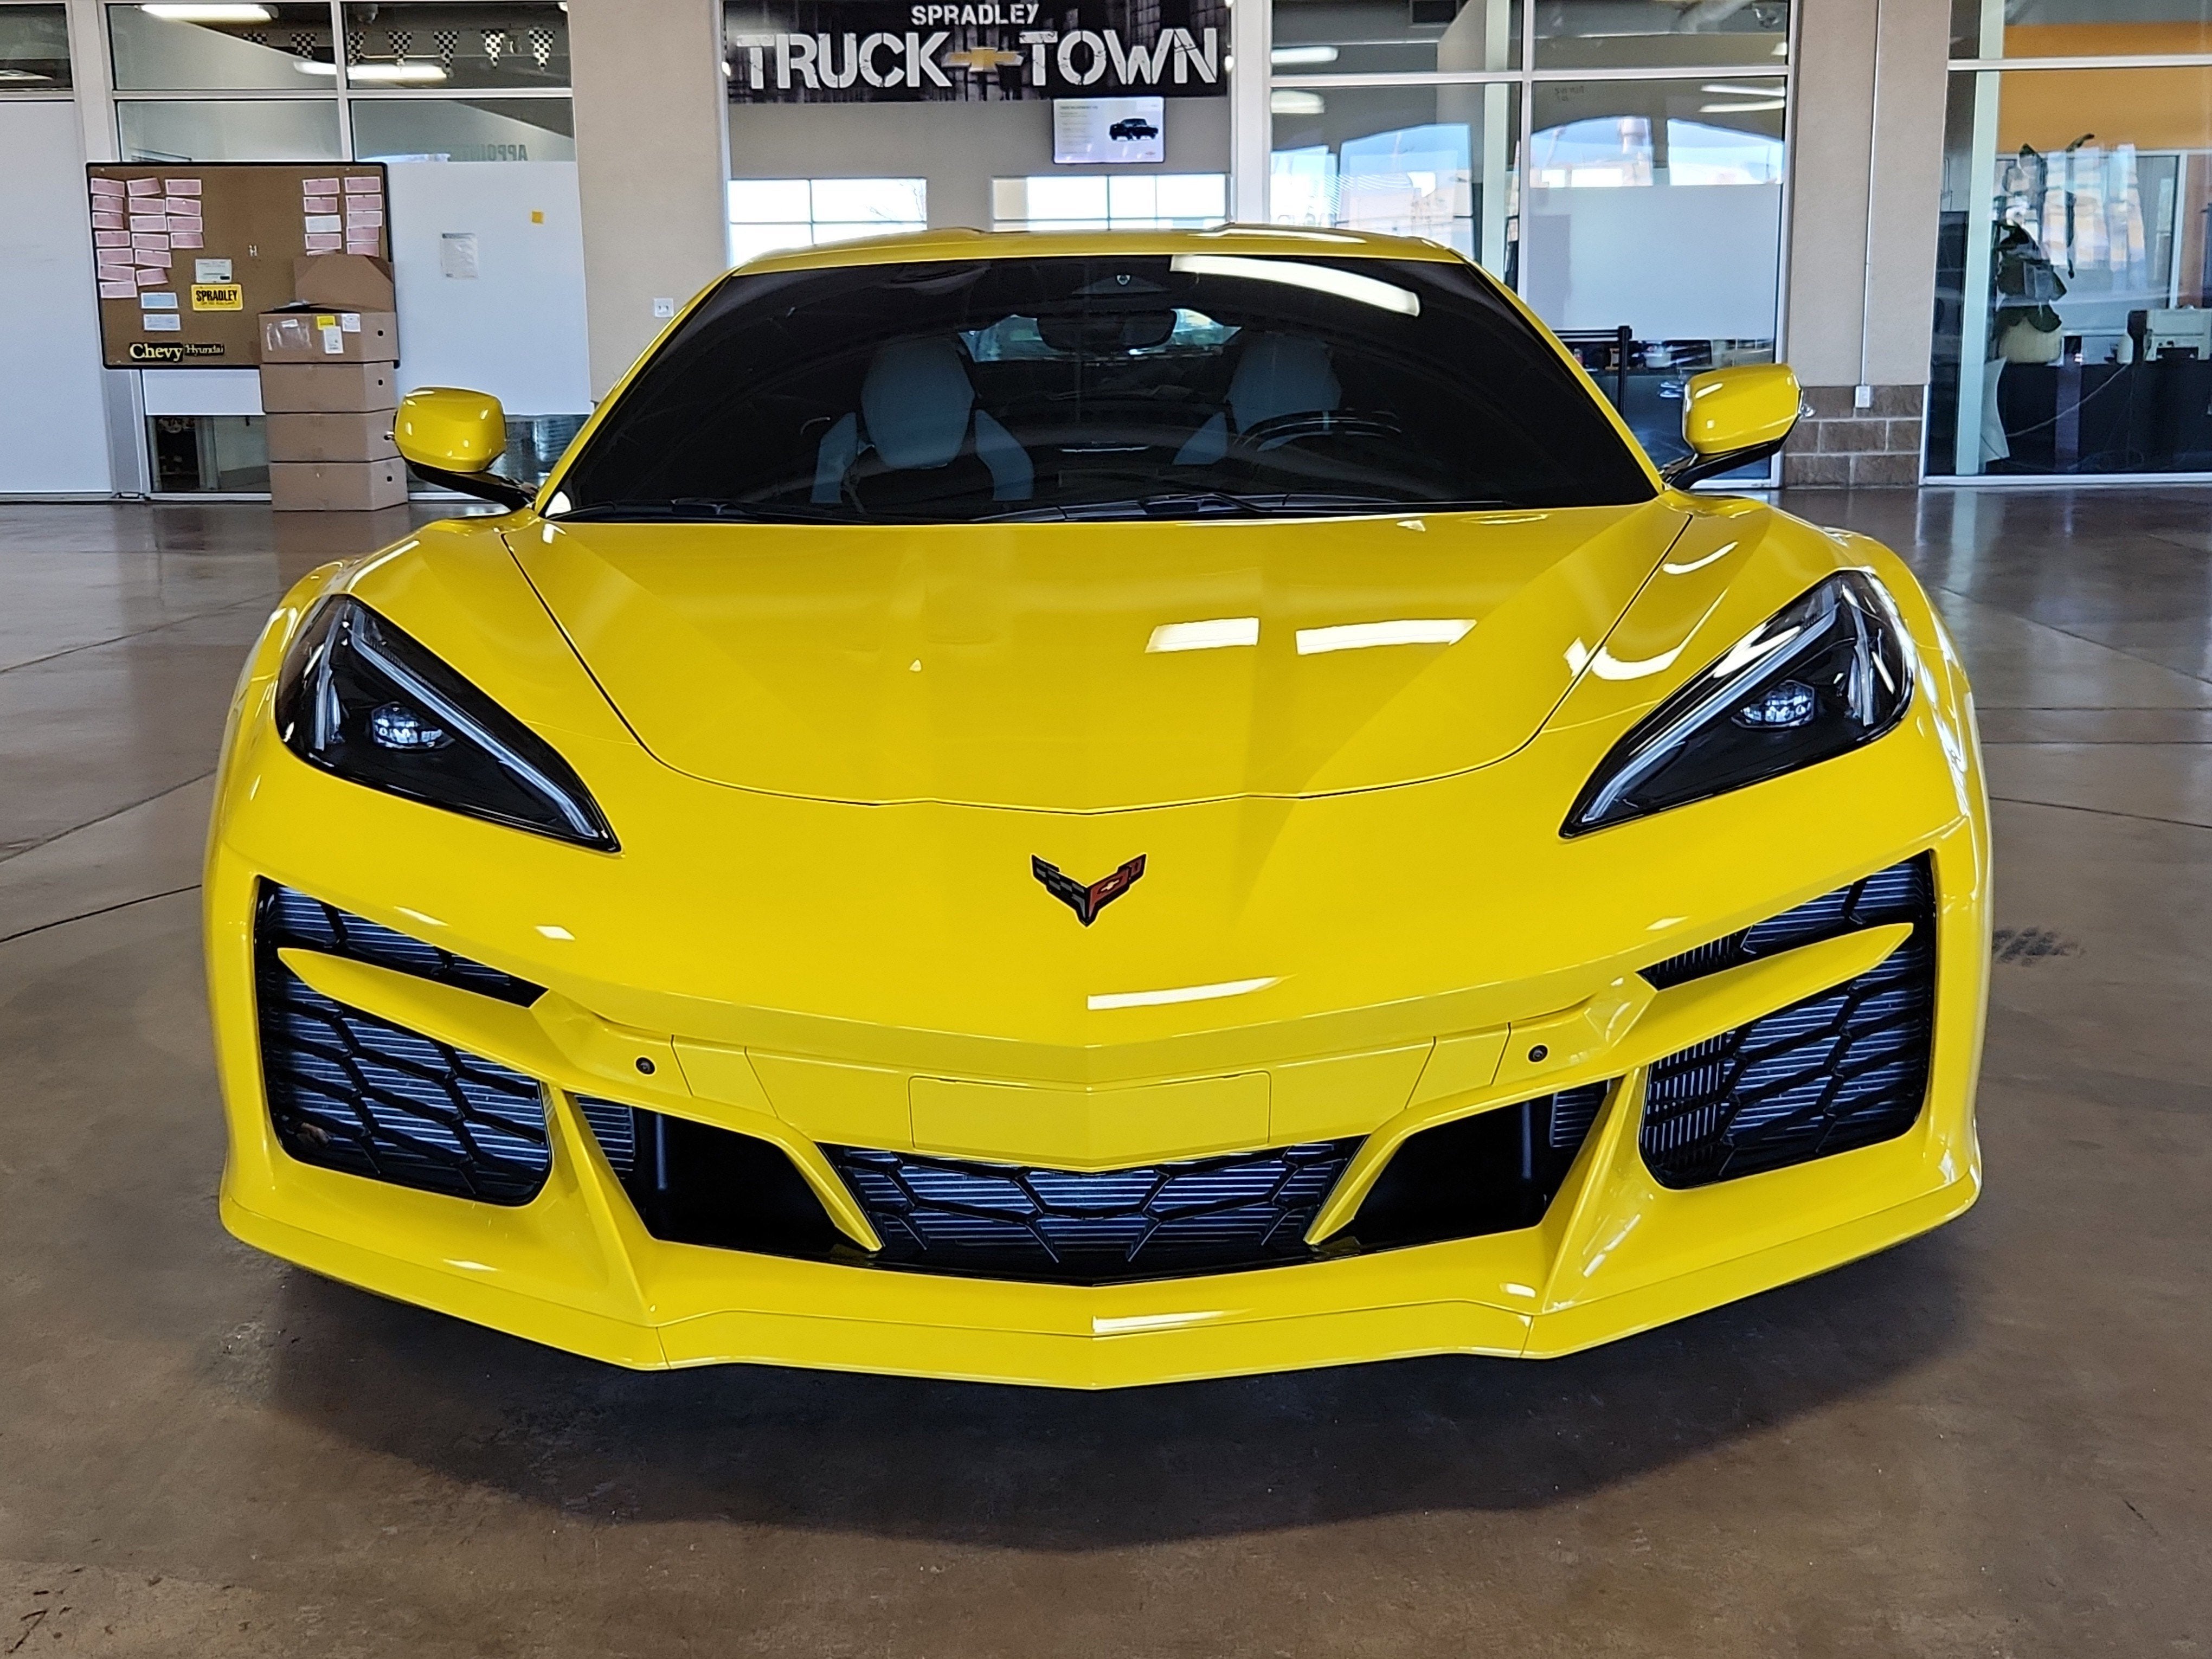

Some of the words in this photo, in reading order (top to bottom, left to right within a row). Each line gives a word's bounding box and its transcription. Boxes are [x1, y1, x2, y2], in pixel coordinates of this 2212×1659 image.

[911, 4, 1039, 25] SPRADLEY
[736, 31, 953, 89] TRUCK
[1019, 28, 1217, 86] TOWN
[196, 290, 237, 302] SPRADLEY
[130, 343, 183, 362] Chevy
[185, 344, 224, 356] Hyundai
